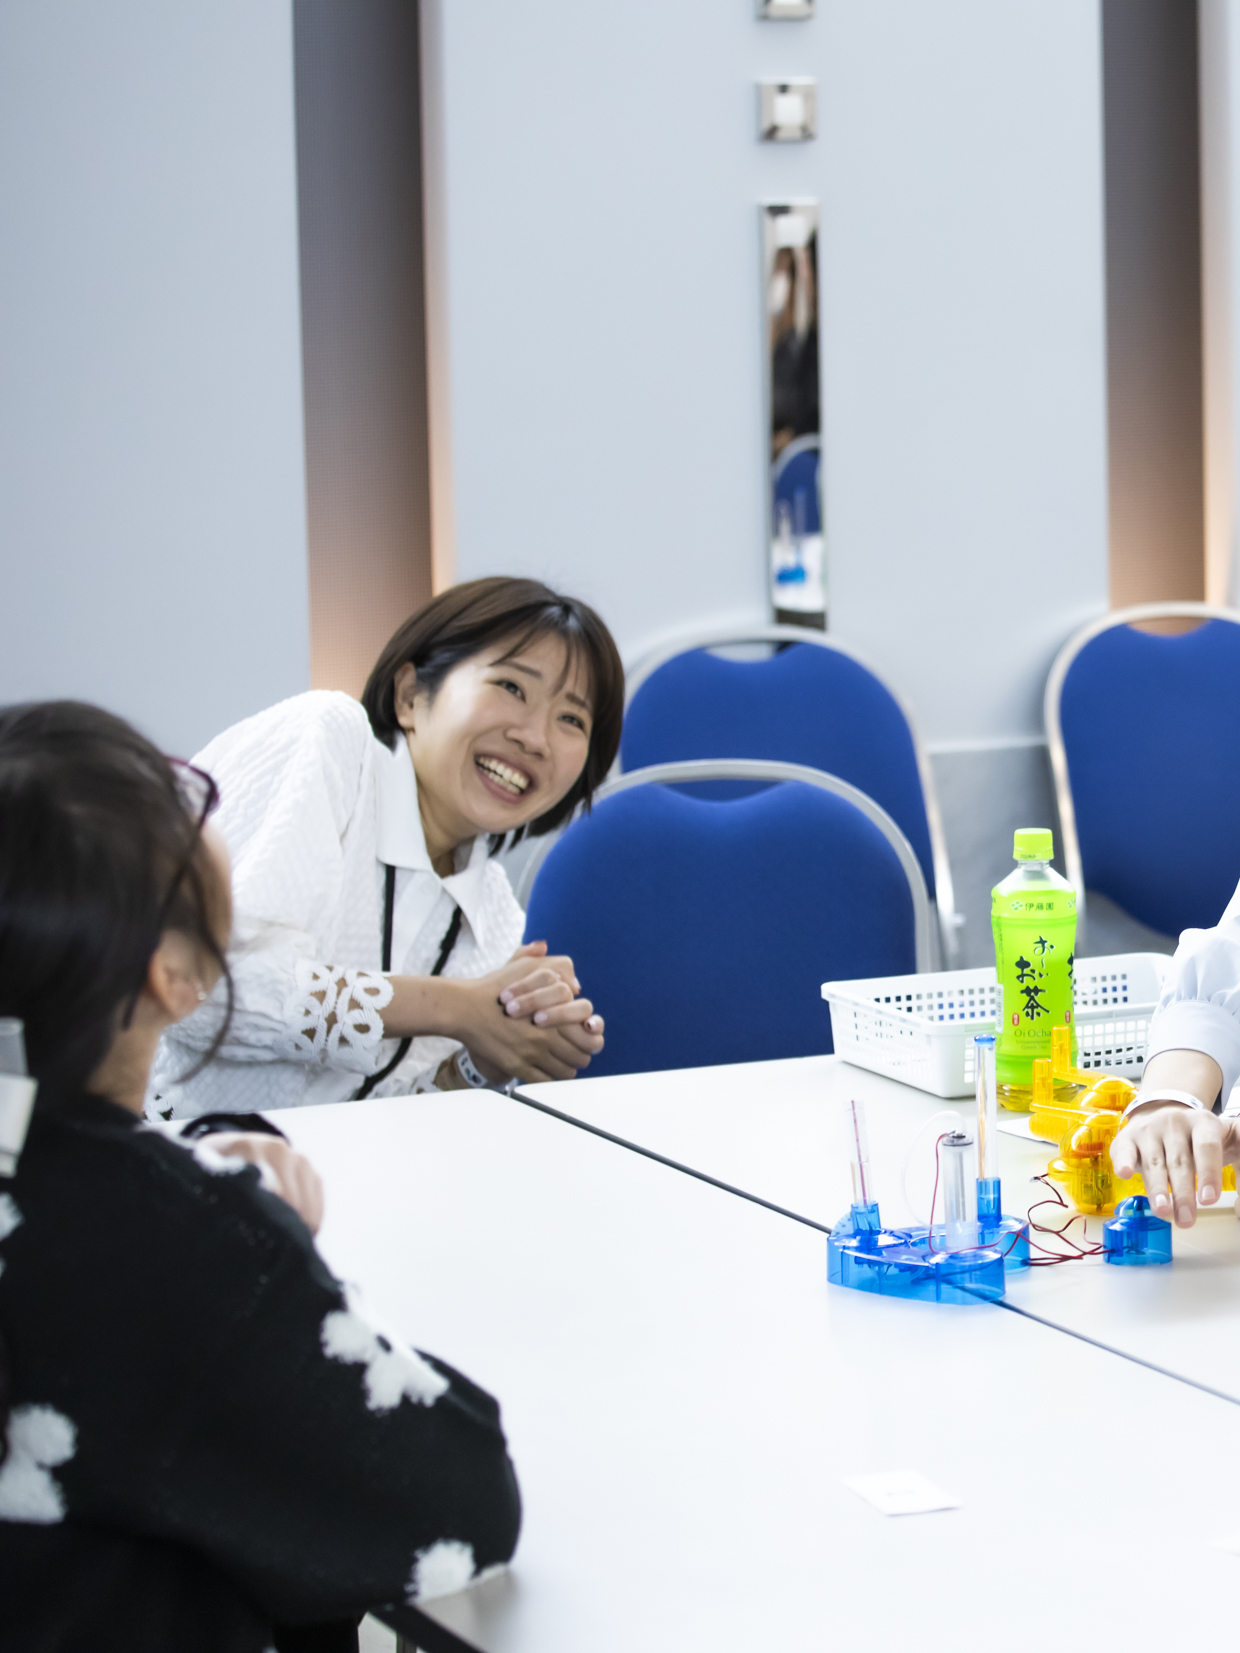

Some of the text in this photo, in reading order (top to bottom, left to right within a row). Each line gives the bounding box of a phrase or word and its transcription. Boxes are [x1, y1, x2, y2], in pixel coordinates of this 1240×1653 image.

[1025, 902, 1054, 911] 伊藤園
[1014, 955, 1050, 1021] お茶
[1014, 1028, 1026, 1038] Oi
